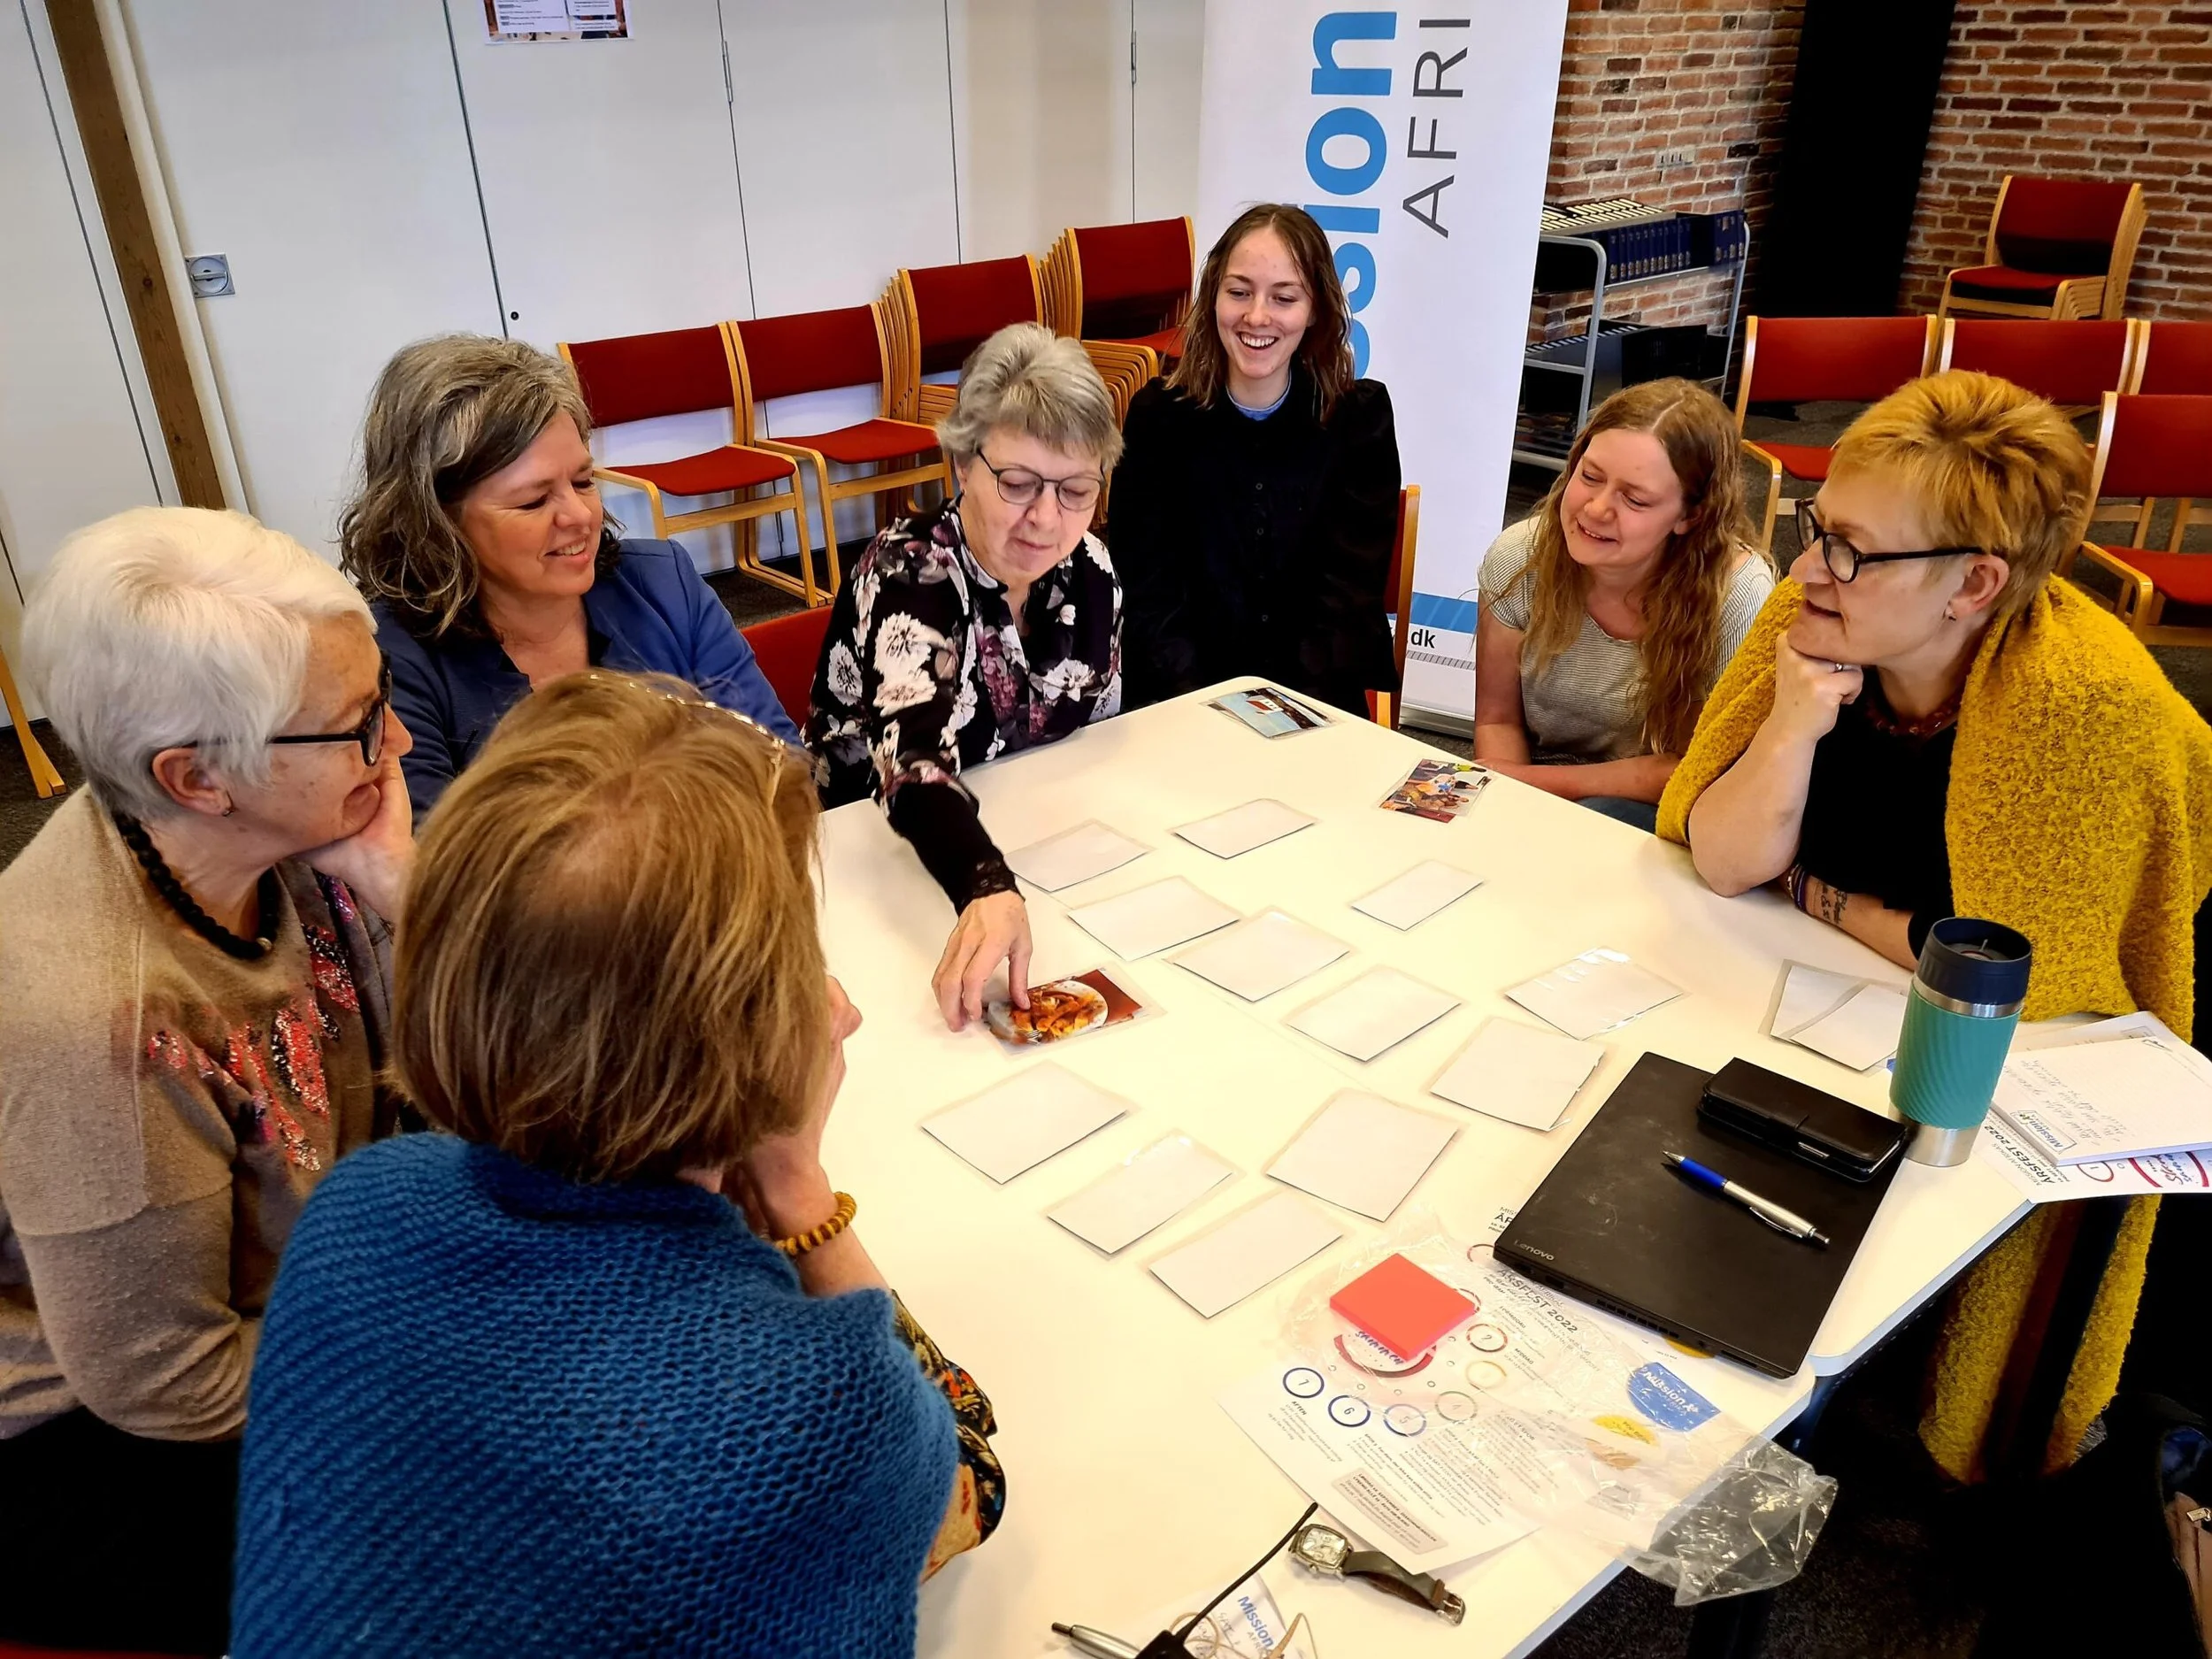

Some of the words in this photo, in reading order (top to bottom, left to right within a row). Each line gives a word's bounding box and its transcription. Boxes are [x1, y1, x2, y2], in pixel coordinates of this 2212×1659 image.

[1402, 19, 1471, 238] AFRI
[1410, 628, 1436, 649] dk
[1983, 1125, 2009, 1144] 2022
[2029, 1121, 2063, 1148] Mission
[2005, 1144, 2055, 1183] ÅRSFEST
[1514, 1239, 1554, 1261] Lenovo
[1547, 1308, 1578, 1333] 2022
[1481, 1333, 1492, 1342] 2
[1342, 1406, 1355, 1416] 6
[1237, 1595, 1274, 1647] Mission
